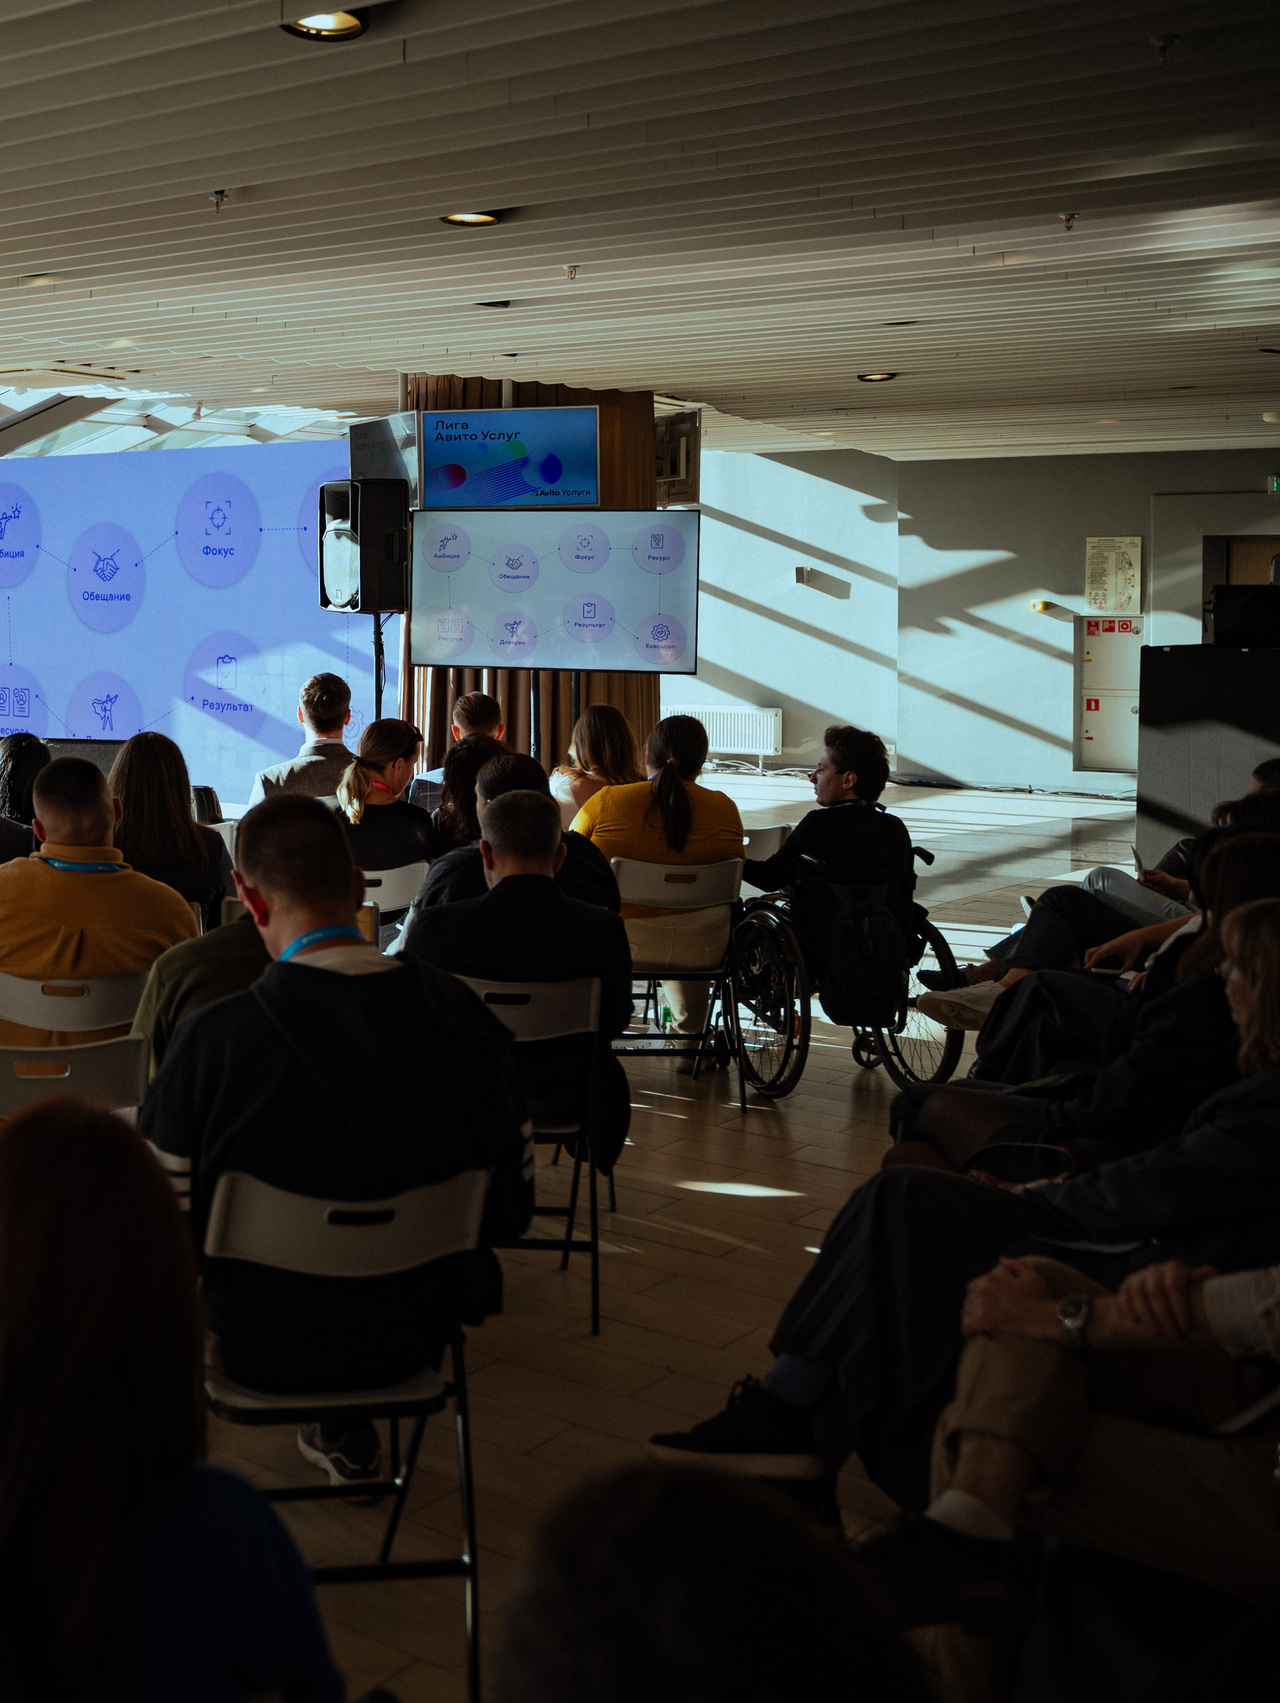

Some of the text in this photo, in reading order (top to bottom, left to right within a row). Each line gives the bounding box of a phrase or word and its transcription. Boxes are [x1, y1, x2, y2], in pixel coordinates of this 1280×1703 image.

[434, 420, 469, 431] Лига
[434, 430, 521, 442] Авито Услуг
[540, 489, 591, 497] Avito Услуги
[202, 545, 235, 558] Фокус
[82, 590, 131, 603] Обещание
[574, 621, 606, 629] Результат
[202, 698, 254, 714] Результат
